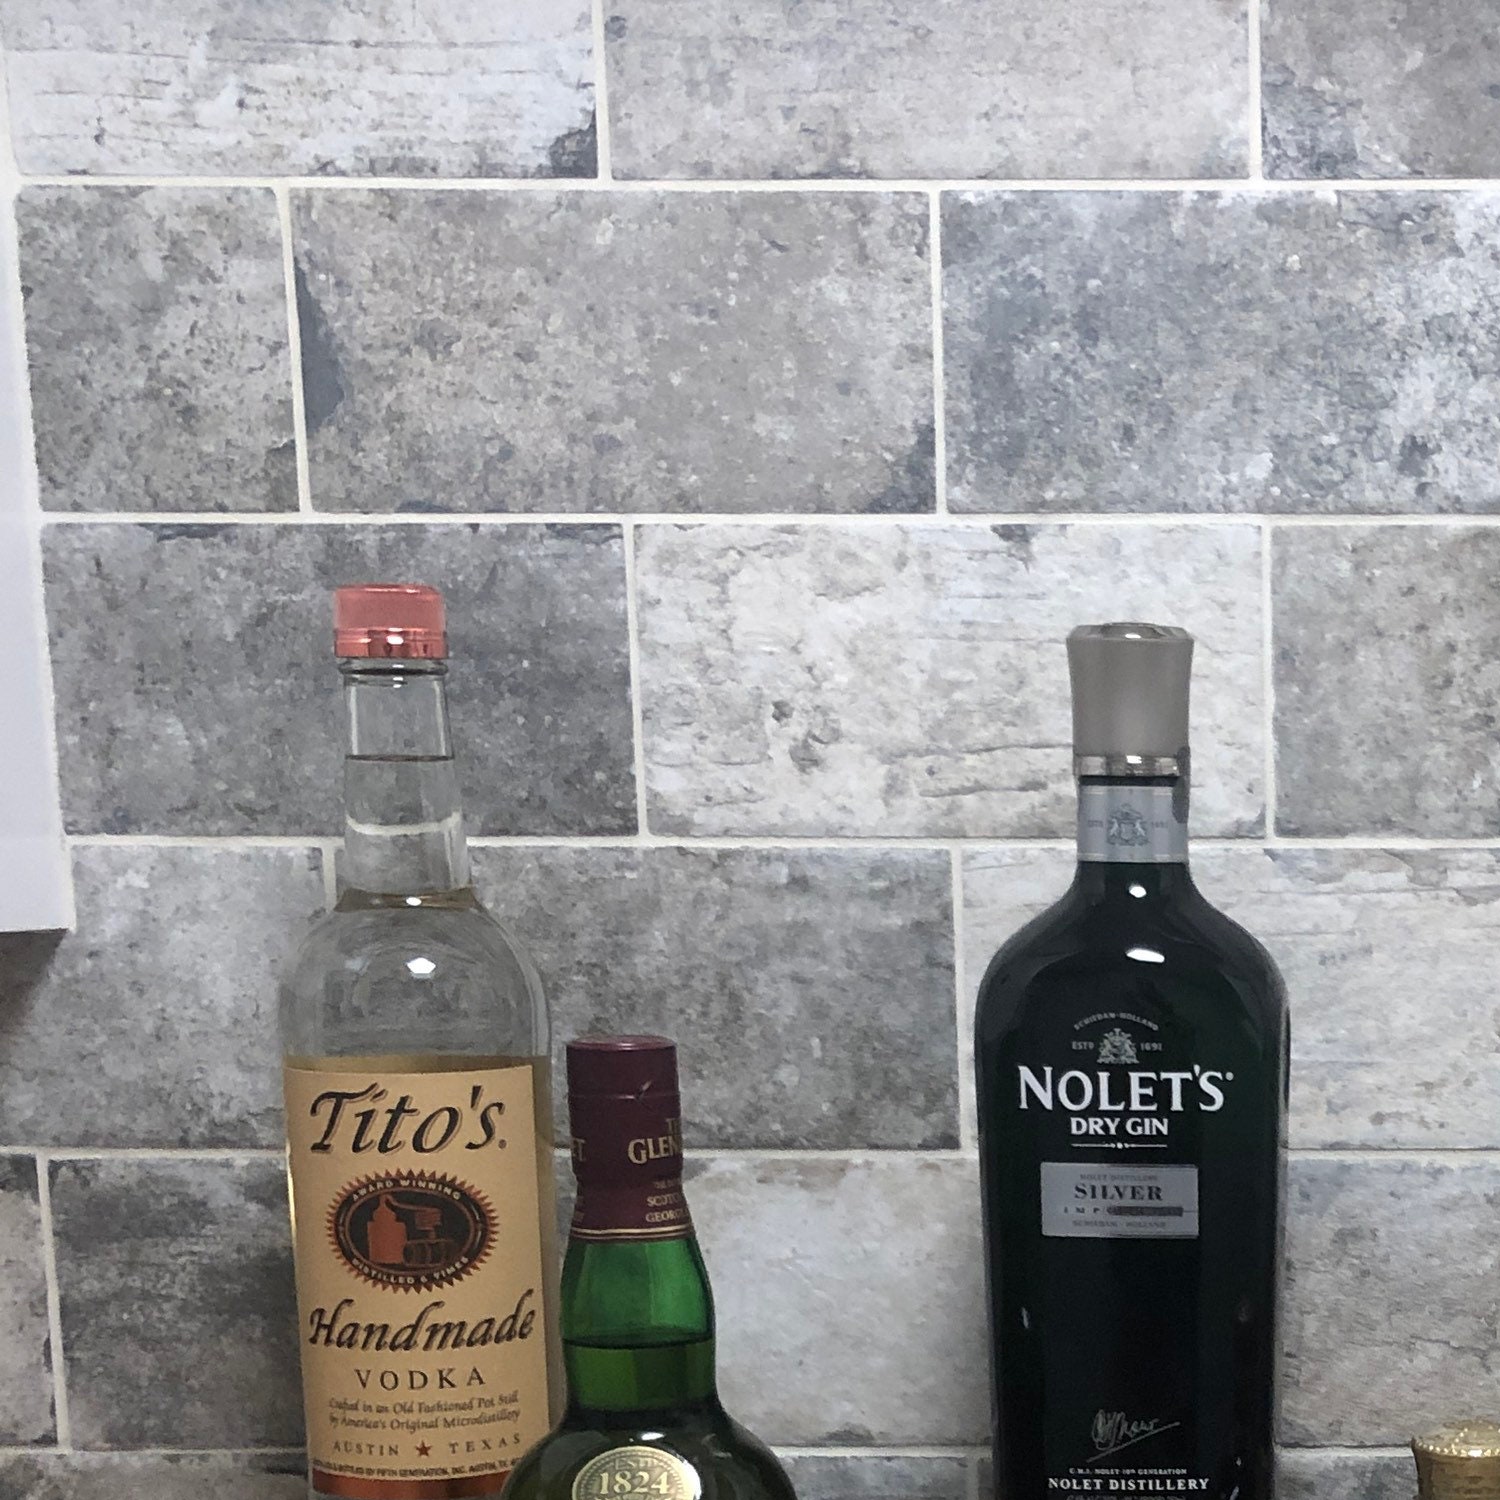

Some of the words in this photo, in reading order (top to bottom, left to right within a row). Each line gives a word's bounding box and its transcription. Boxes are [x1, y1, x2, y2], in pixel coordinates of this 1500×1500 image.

[1017, 1064, 1224, 1112] NOLET'S
[310, 1082, 505, 1155] Tito's
[1070, 1117, 1121, 1135] DRY
[1125, 1118, 1169, 1136] GIN
[352, 1180, 394, 1201] AWARD
[400, 1179, 462, 1200] WINNING
[1074, 1182, 1163, 1201] SILVER
[351, 1257, 415, 1284] DISTILLED
[433, 1256, 469, 1280] TIMES
[308, 1288, 536, 1352] Handmade
[354, 1366, 487, 1392] VODKA
[393, 1402, 414, 1415] Old
[390, 1417, 438, 1434] Original
[332, 1440, 399, 1457] AUSTIN
[449, 1434, 521, 1455] TEXAS
[600, 1470, 670, 1494] 1824
[1048, 1478, 1103, 1490] NOLET
[1108, 1478, 1210, 1491] DISTILLERY
